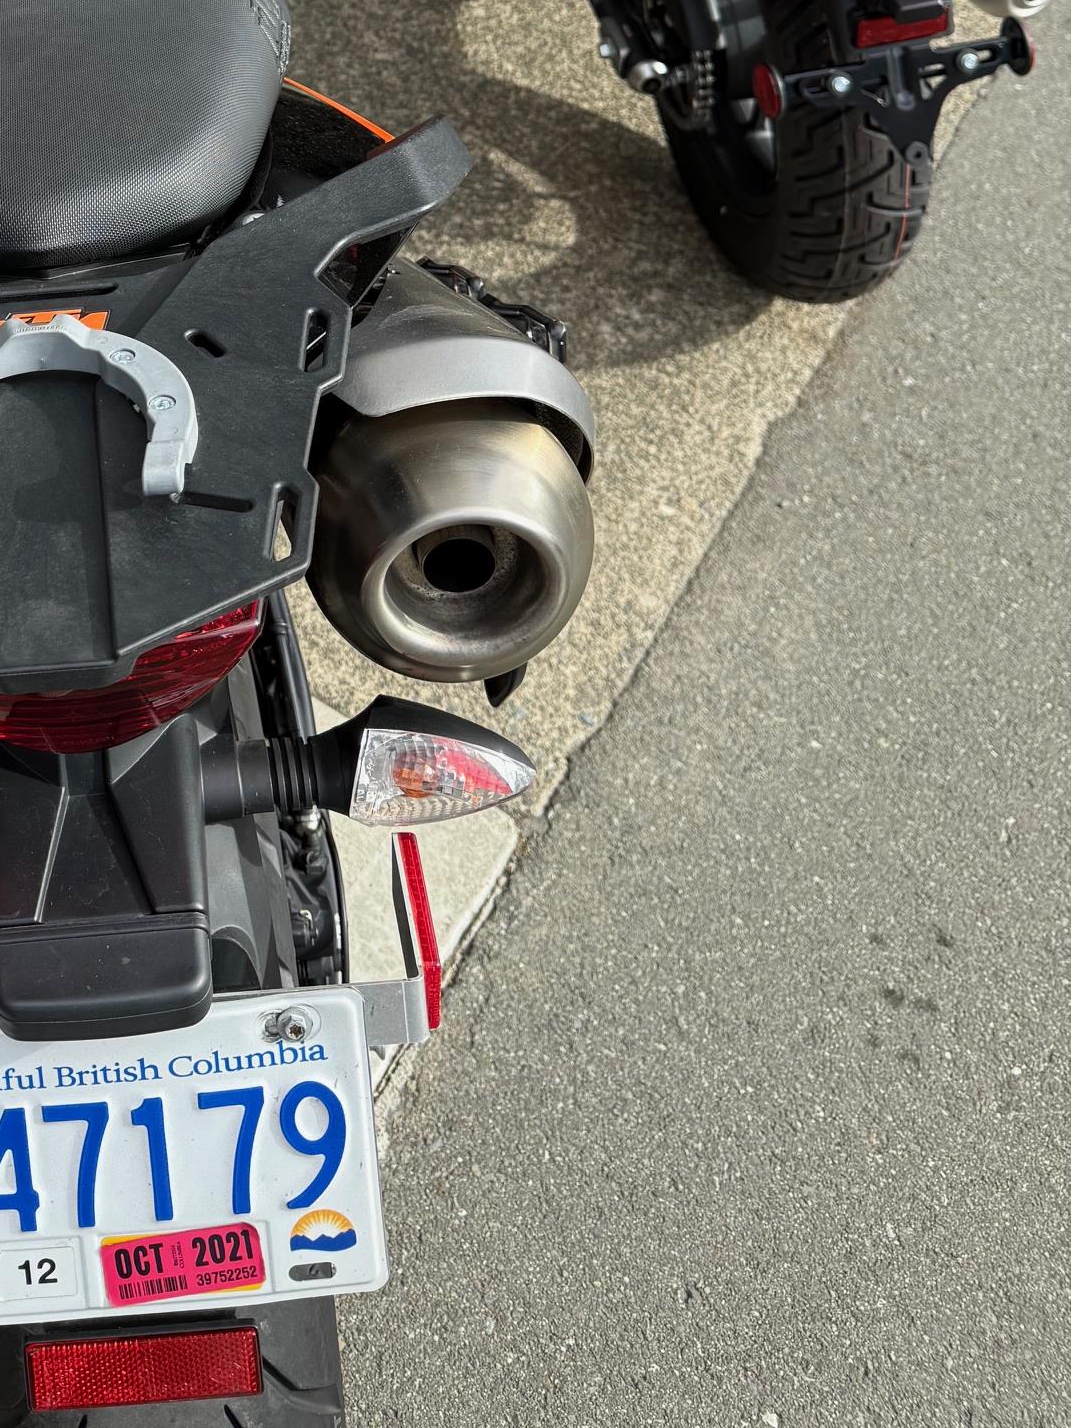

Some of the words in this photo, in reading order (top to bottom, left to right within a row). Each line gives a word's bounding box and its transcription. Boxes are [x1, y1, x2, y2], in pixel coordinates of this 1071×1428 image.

[54, 1059, 163, 1088] British
[167, 1040, 329, 1079] Columbia
[17, 1257, 59, 1286] 12
[114, 1242, 164, 1280] OCT
[191, 1229, 254, 1267] 2021
[196, 1265, 258, 1287] 39752252
